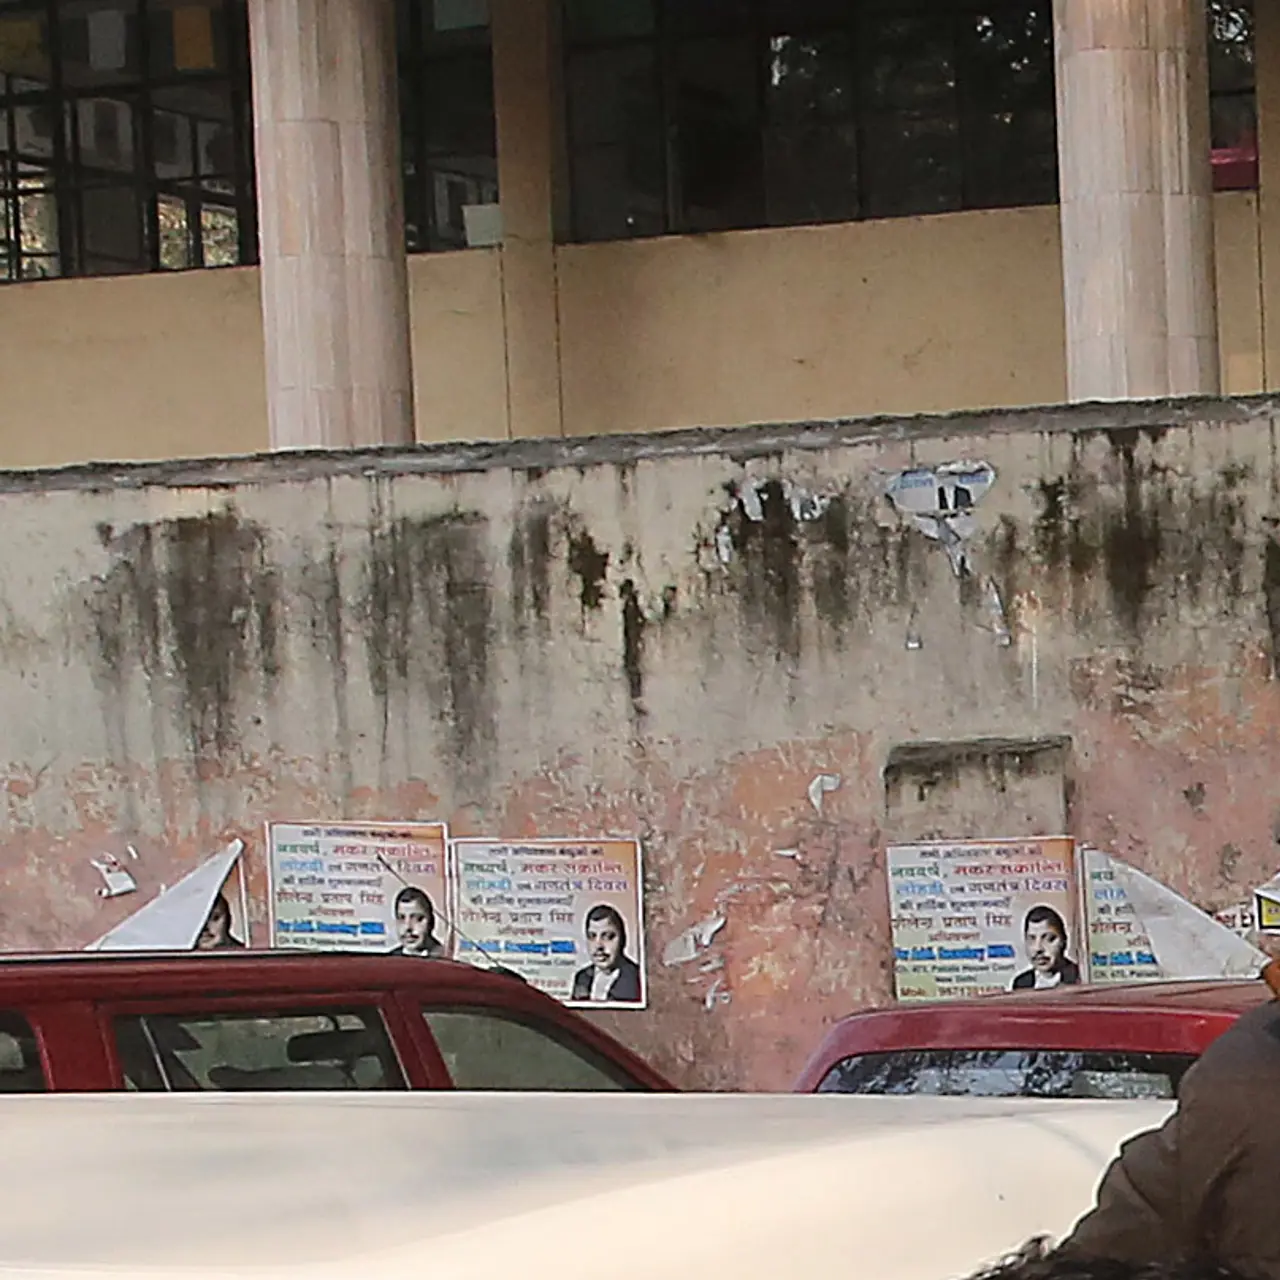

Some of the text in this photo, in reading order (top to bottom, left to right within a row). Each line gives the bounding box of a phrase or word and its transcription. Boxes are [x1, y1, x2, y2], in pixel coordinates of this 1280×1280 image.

[522, 863, 557, 874] मकर
[953, 864, 992, 875] मकर
[588, 879, 627, 891] दिवस
[968, 879, 1019, 894] गणतंत्र
[1024, 878, 1068, 892] दिवस
